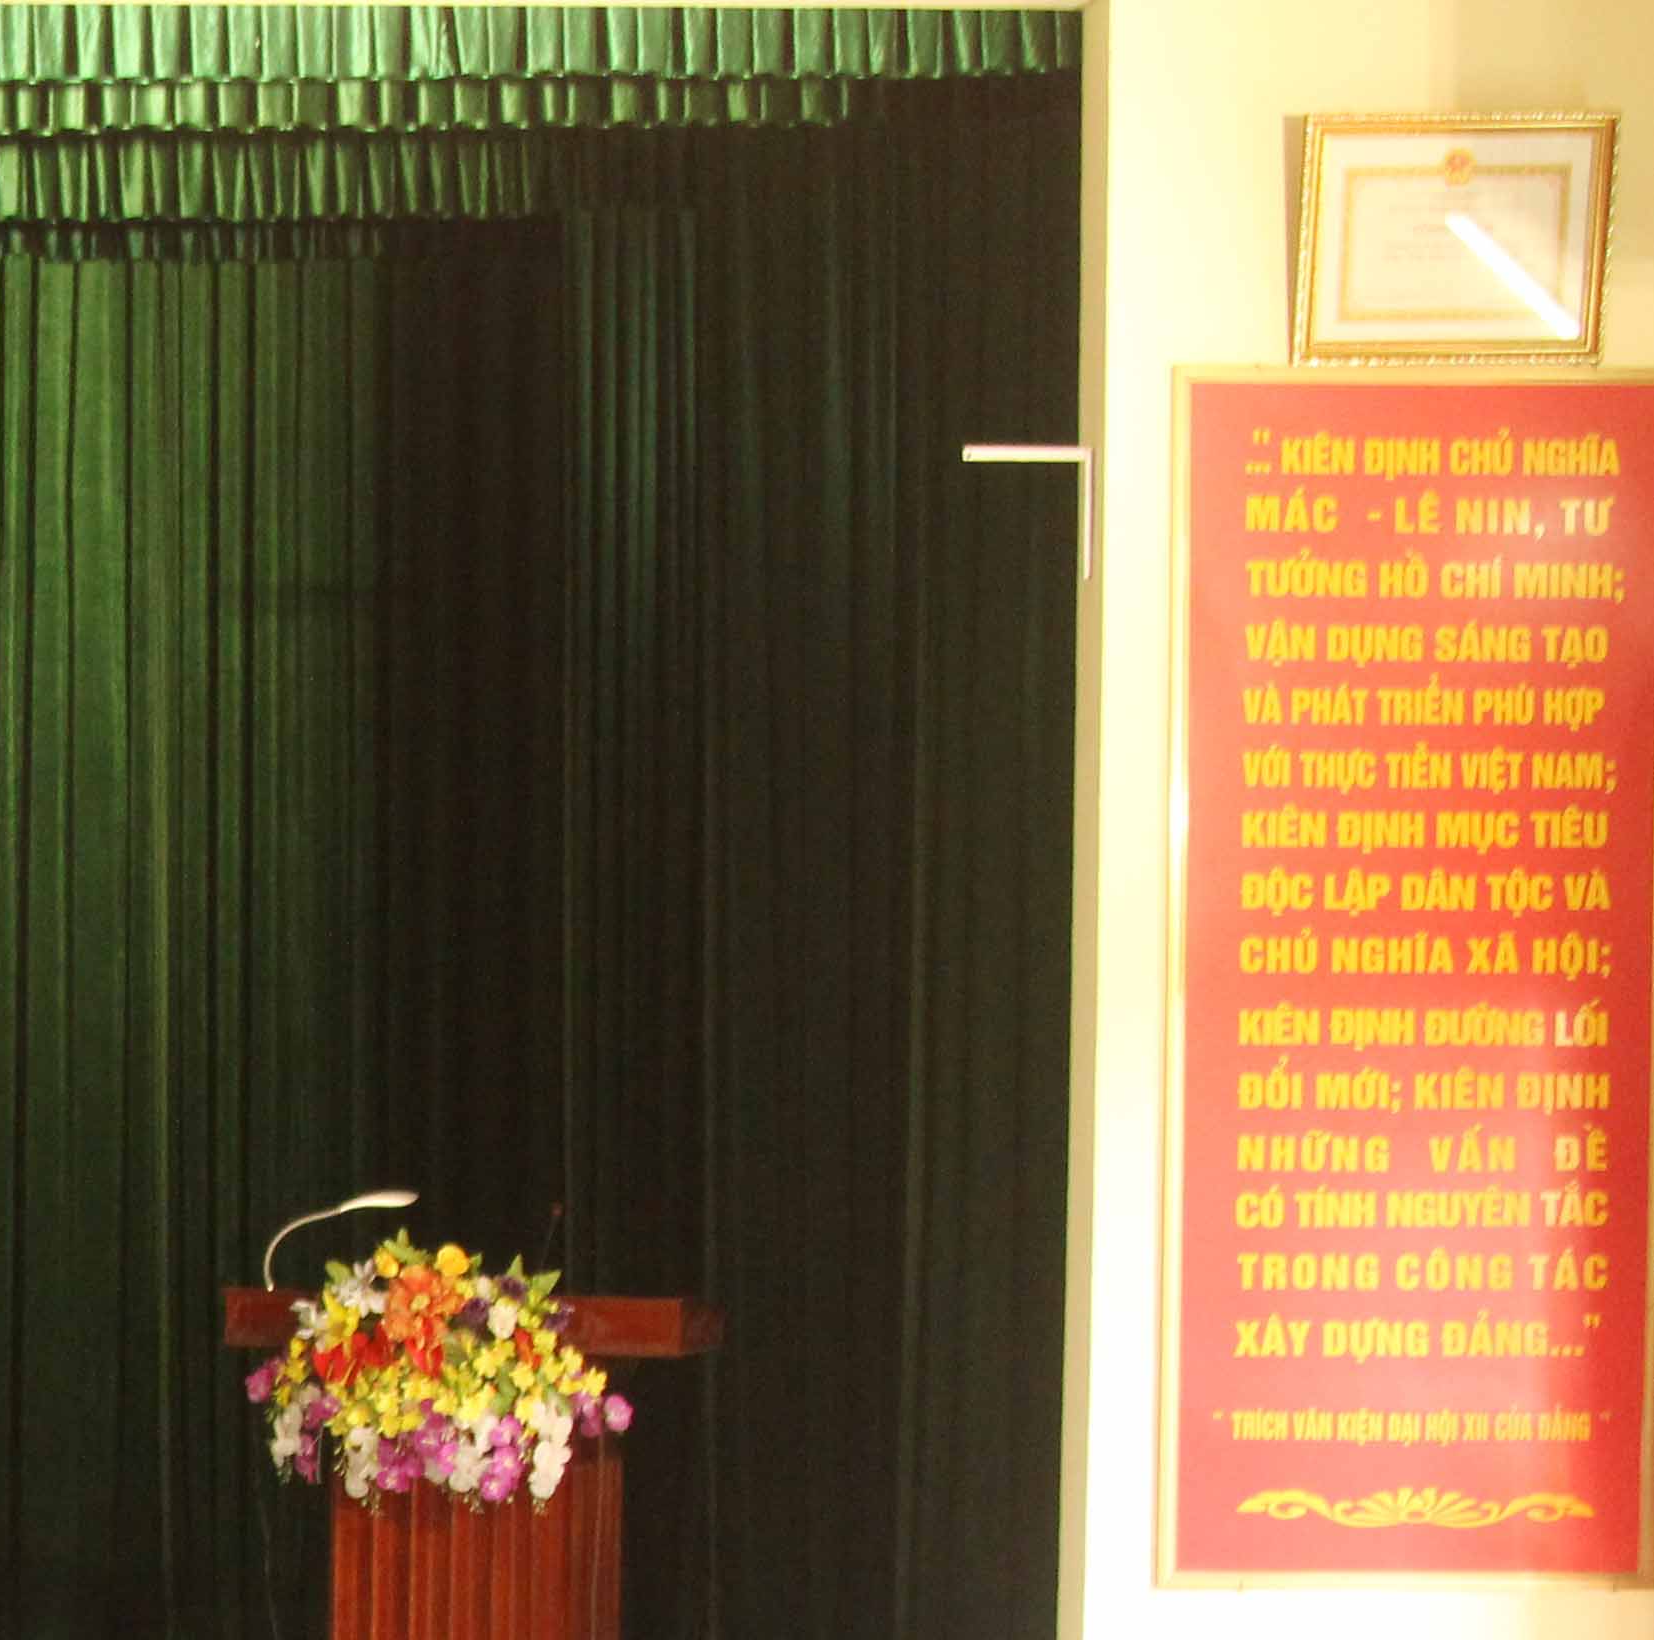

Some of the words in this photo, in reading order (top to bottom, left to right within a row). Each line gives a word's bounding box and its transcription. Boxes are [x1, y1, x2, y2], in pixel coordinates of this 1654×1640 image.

[1280, 431, 1355, 475] KIÊN
[1363, 438, 1441, 481] ĐỊNH
[1449, 428, 1513, 476] CHỦ
[1521, 433, 1619, 478] NGHĨA
[1245, 487, 1337, 532] MÁC
[1395, 491, 1440, 534] LÊ
[1456, 498, 1547, 541] NIN,
[1559, 497, 1613, 538] TƯ
[1244, 548, 1368, 598] TƯỞNG
[1379, 550, 1429, 598] HỒ
[1512, 564, 1623, 602] MINH;
[1244, 617, 1316, 667] VẬN
[1326, 624, 1423, 667] DỤNG
[1433, 619, 1532, 662] SÁNG
[1540, 624, 1609, 668] TẠO
[1242, 681, 1282, 724] VÀ
[1290, 683, 1369, 725] PHÁT
[1376, 672, 1465, 725] TRIỂN
[1472, 682, 1535, 725] PHÙ
[1542, 686, 1605, 731] HỢP
[1242, 744, 1291, 787] VỚI
[1299, 748, 1376, 794] THỰC
[1460, 746, 1523, 794] VIỆT
[1531, 751, 1616, 793] NAM;
[1241, 803, 1327, 848] KIÊN
[1335, 810, 1425, 854] ĐỊNH
[1435, 810, 1519, 854] MỤC
[1529, 804, 1607, 848] TIÊU
[1239, 866, 1313, 916] ĐỘC
[1324, 868, 1392, 916] LẬP
[1401, 867, 1476, 911] DÂN
[1485, 867, 1553, 918] TỘC
[1563, 869, 1610, 910] VÀ
[1239, 927, 1318, 973] CHỦ
[1331, 932, 1453, 974] NGHĨA
[1466, 932, 1519, 974] XÃ
[1531, 932, 1610, 981] HỘI;
[1238, 1002, 1321, 1046] KIÊN
[1329, 1008, 1416, 1051] ĐỊNH
[1554, 1000, 1607, 1048] LỐI
[1238, 1055, 1303, 1109] ĐỔI
[1316, 1066, 1401, 1113] MỚI;
[1414, 1067, 1504, 1110] KIÊN
[1515, 1070, 1609, 1114] ĐỊNH
[1429, 1124, 1515, 1173] VẤN
[1552, 1123, 1606, 1174] ĐỀ
[1236, 1184, 1285, 1228] CÓ
[1294, 1185, 1377, 1228] TÍNH
[1386, 1185, 1530, 1228] NGUYÊN
[1540, 1180, 1607, 1229] TẮC
[1237, 1253, 1380, 1291] TRONG
[1396, 1247, 1512, 1291] CÔNG
[1527, 1248, 1606, 1292] TÁC
[1234, 1313, 1312, 1357] XÂY
[1323, 1317, 1429, 1363] DỰNG
